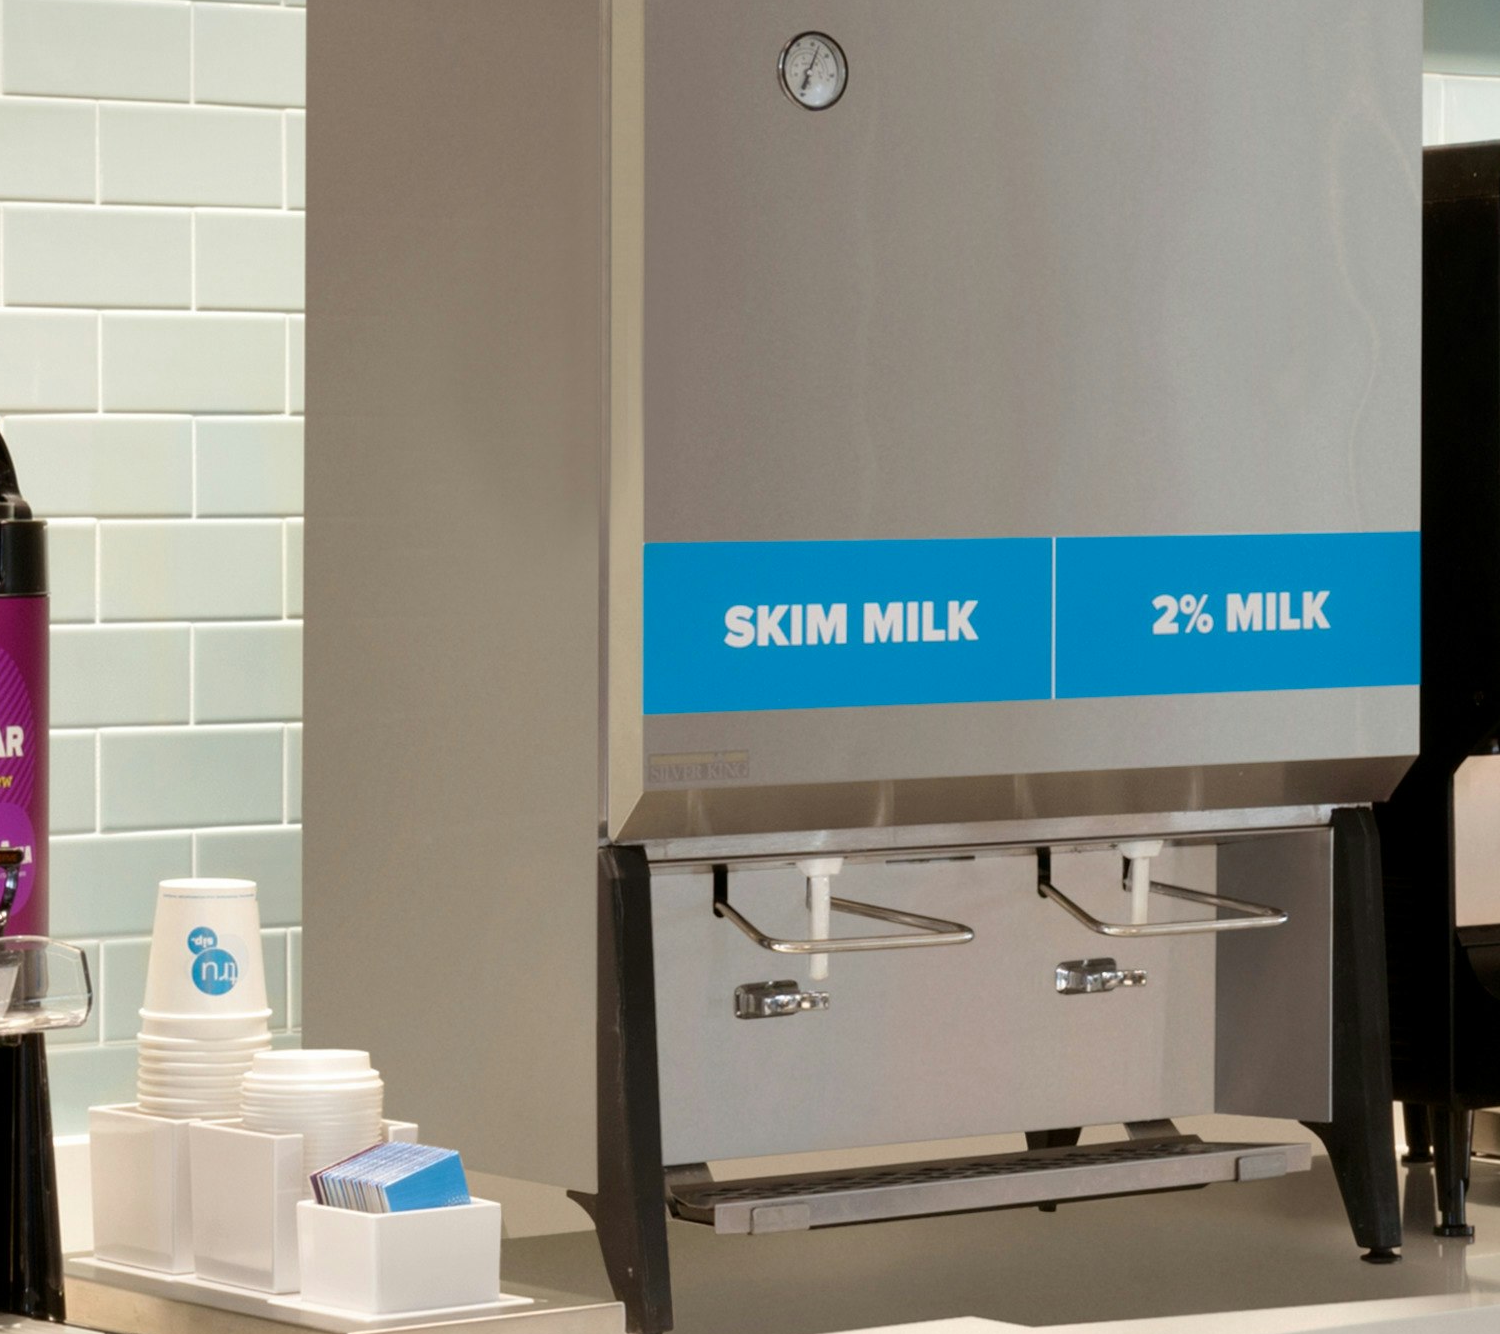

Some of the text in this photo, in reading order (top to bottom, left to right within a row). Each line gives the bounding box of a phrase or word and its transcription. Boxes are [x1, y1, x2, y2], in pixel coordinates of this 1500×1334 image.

[723, 600, 979, 649] SKIM MILK
[1151, 590, 1332, 636] 2% MILK
[650, 762, 748, 783] SILVER KING
[202, 961, 238, 986] tru
